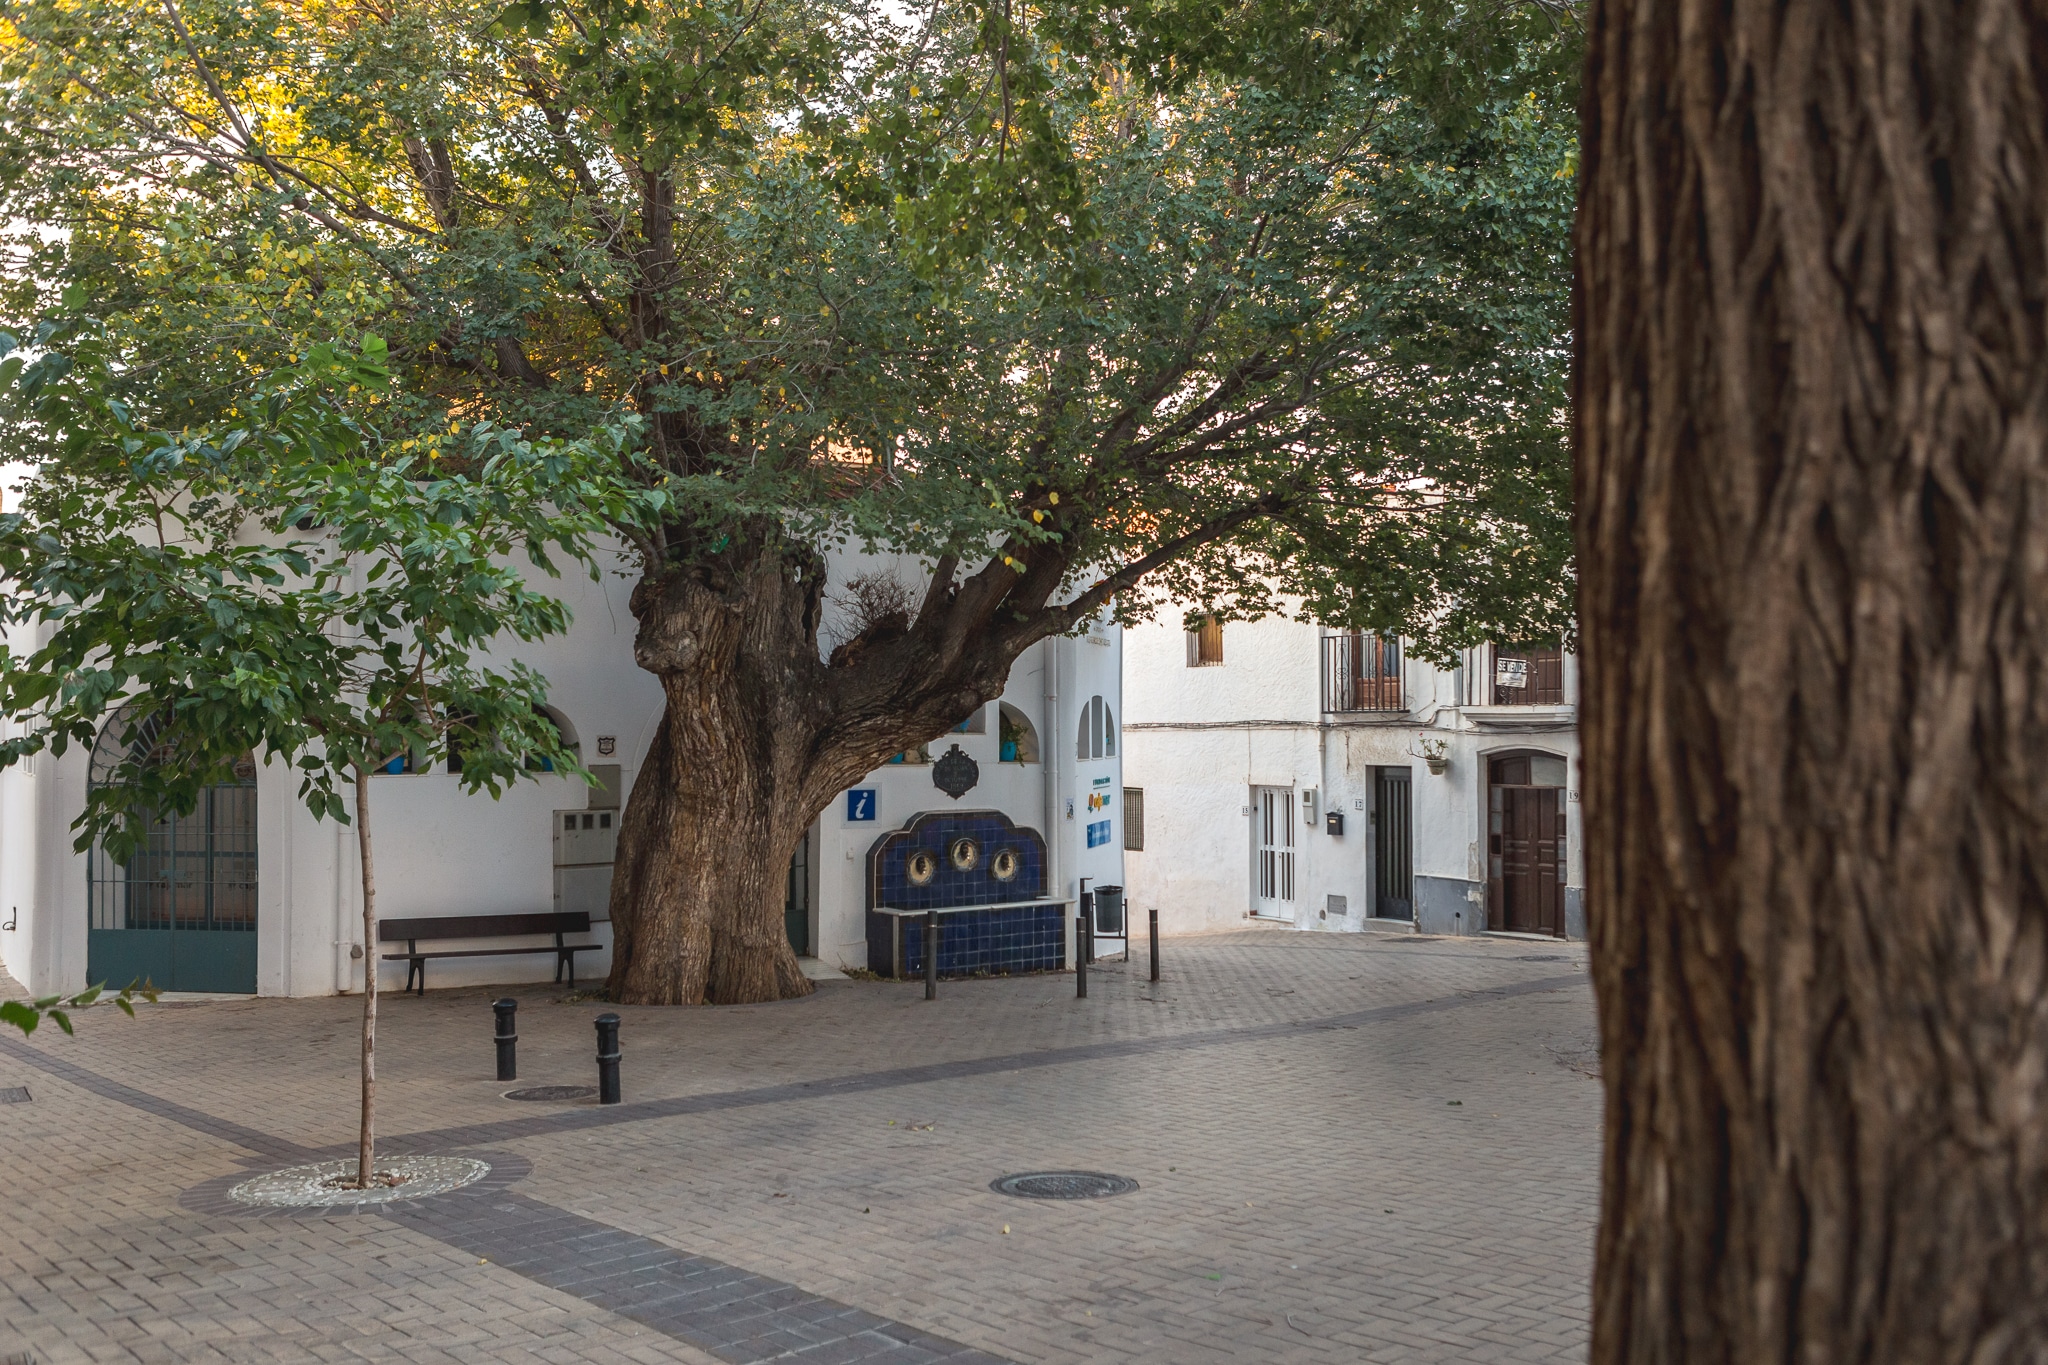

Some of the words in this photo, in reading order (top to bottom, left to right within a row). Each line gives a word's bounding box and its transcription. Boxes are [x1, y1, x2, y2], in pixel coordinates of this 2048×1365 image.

[1498, 660, 1507, 671] SE
[1507, 661, 1527, 673] VENDE
[1569, 791, 1579, 800] 19
[1354, 800, 1362, 808] 17
